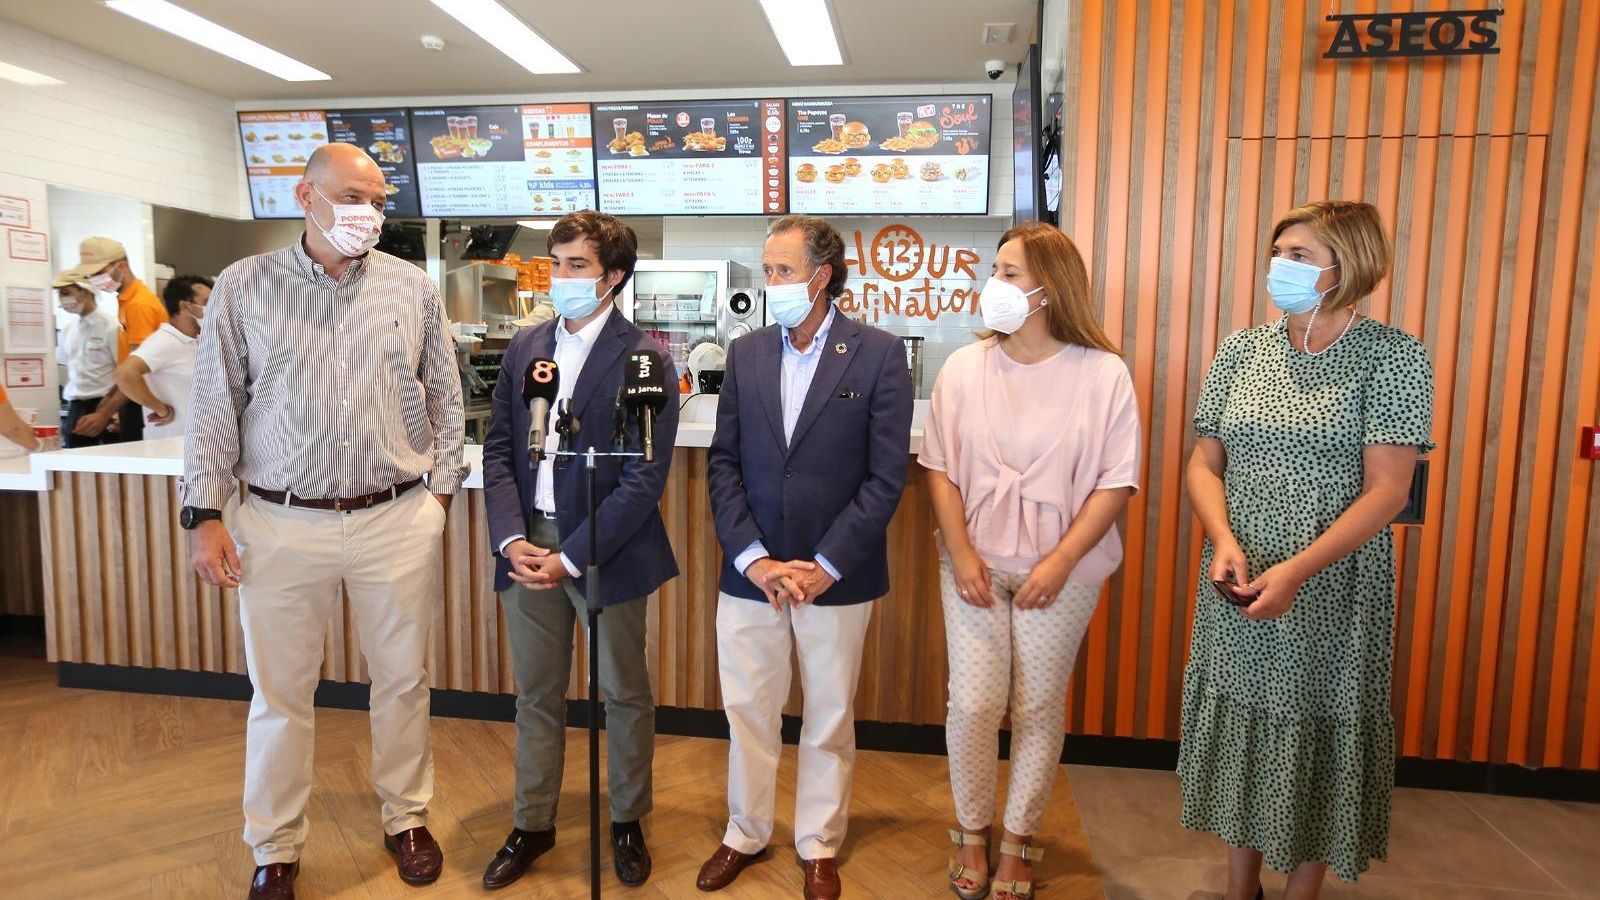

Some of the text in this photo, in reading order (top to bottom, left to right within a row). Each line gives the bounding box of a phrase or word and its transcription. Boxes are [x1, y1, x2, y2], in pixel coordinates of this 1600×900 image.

[1327, 13, 1498, 55] ASEOS
[940, 103, 978, 129] Soul
[527, 140, 569, 148] COMPLEMENTOS
[539, 181, 555, 189] kids
[532, 360, 555, 384] 8
[638, 386, 663, 394] janda
